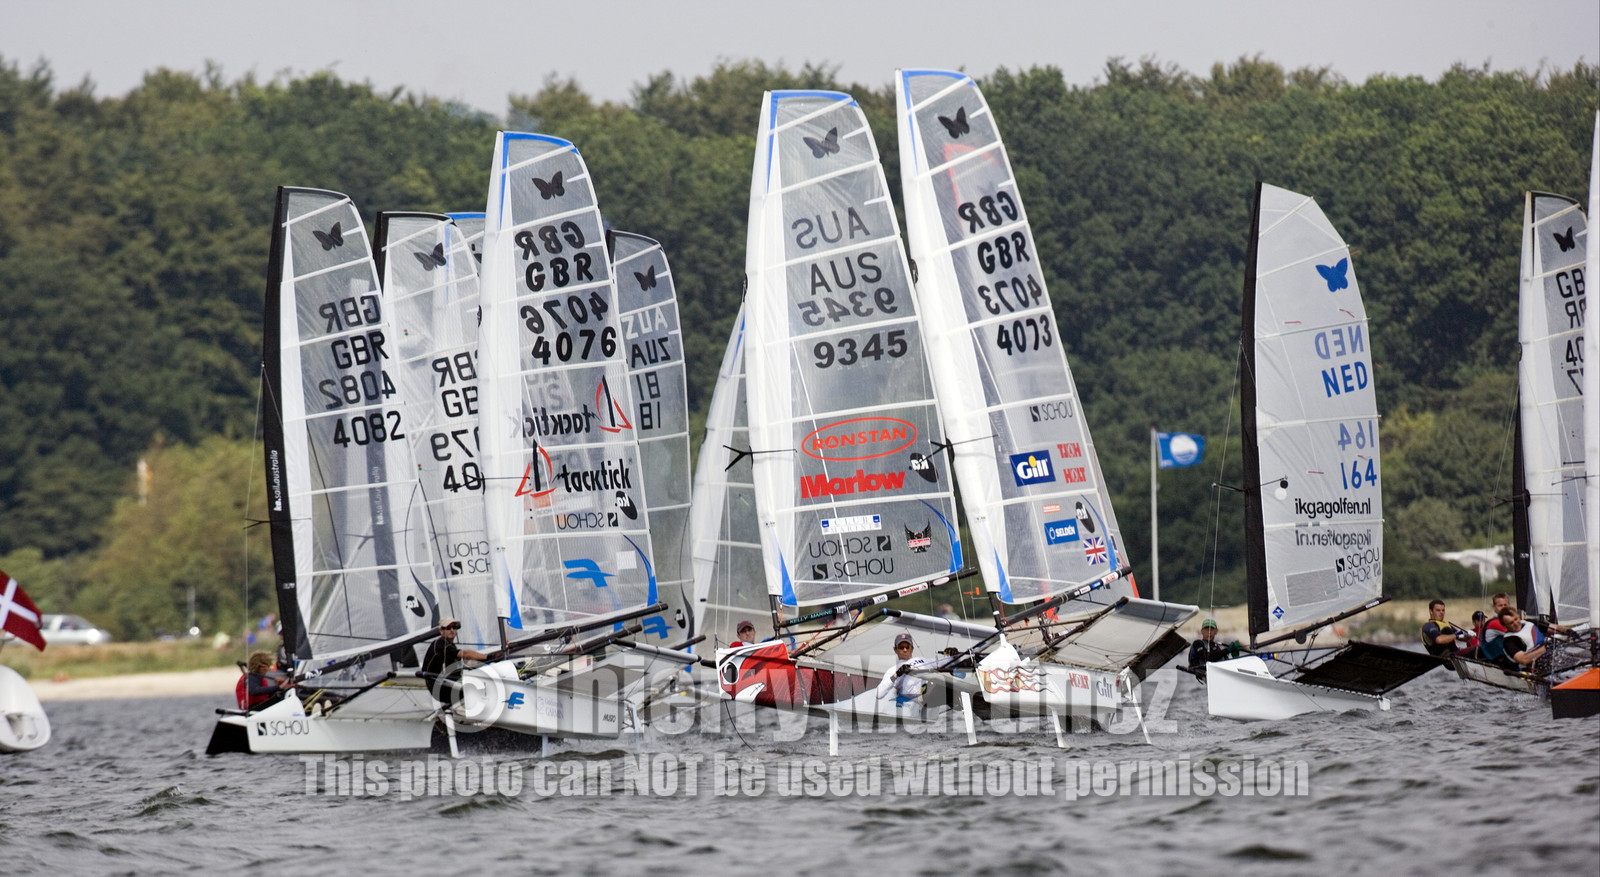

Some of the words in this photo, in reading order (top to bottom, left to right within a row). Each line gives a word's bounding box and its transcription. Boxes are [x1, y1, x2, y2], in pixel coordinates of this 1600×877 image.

[977, 231, 1030, 274] GBR
[525, 252, 593, 292] GBR
[810, 252, 882, 296] AUS
[1556, 267, 1586, 299] GB
[330, 331, 389, 369] GBR
[531, 326, 616, 365] 4076
[813, 329, 908, 369] 9345
[997, 314, 1052, 356] 4073
[1565, 336, 1585, 366] 40
[1321, 361, 1368, 397] NED
[441, 386, 478, 418] GB
[1041, 401, 1073, 421] SCHOU
[333, 410, 405, 448] 4082
[812, 427, 907, 451] RONSTAN
[443, 462, 483, 493] 40
[561, 458, 632, 493] tacktick
[1016, 455, 1050, 480] Gill
[1063, 467, 1087, 484] HOLT
[1340, 459, 1377, 490] 164
[800, 469, 906, 499] Marlow
[1295, 498, 1371, 519] ikgagolfen.nl
[834, 558, 894, 579] SCHOU
[1346, 547, 1380, 570] SCHOU
[789, 615, 808, 625] KELLY
[810, 609, 833, 619] MARINE
[271, 720, 310, 736] SCHOU
